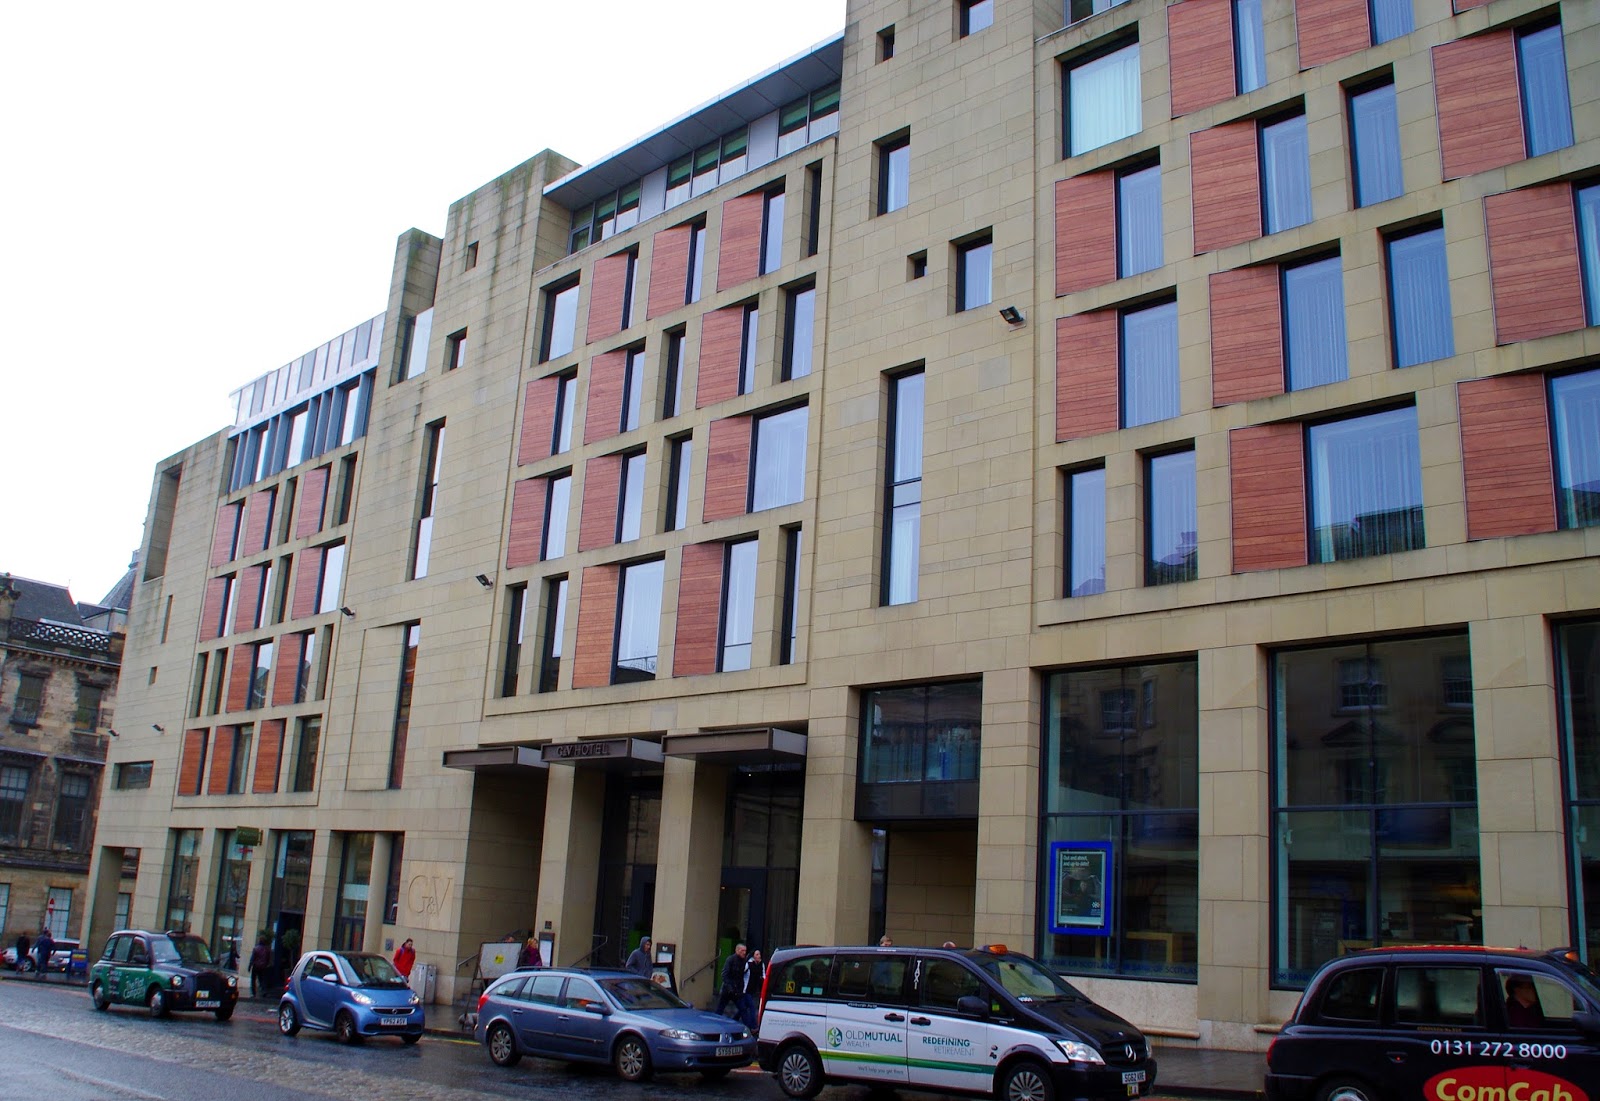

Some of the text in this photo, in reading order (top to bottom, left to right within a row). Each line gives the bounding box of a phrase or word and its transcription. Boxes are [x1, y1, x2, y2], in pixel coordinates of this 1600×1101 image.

[575, 743, 608, 756] HOTEL
[407, 874, 453, 917] G&V
[913, 960, 922, 990] TAXI
[845, 1040, 870, 1048] WEALTH
[922, 1036, 971, 1047] REDEFINING
[1430, 1039, 1567, 1059] 0131 272 8000
[933, 1046, 975, 1056] RETIREMENT
[1436, 1077, 1573, 1101] ComCab
